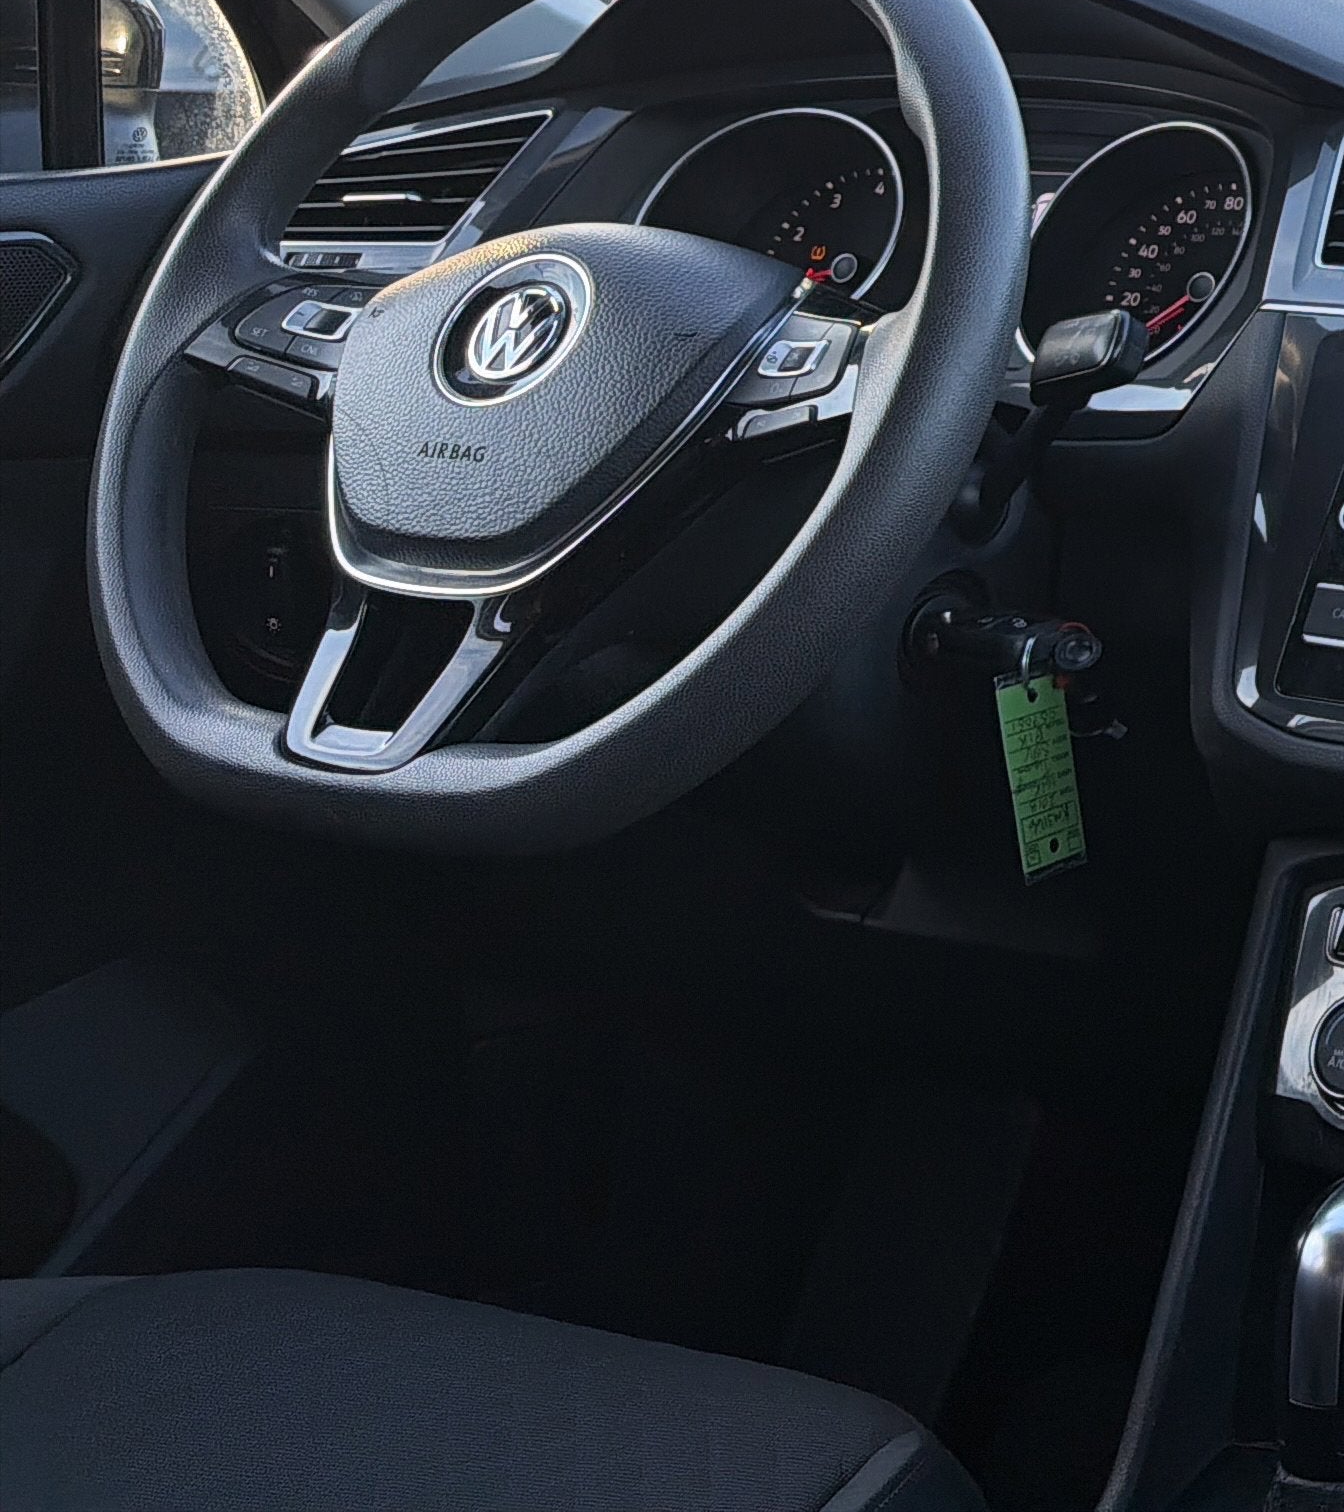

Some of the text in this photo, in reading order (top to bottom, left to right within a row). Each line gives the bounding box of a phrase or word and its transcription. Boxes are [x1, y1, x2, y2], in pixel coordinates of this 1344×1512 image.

[874, 181, 886, 196] 4
[830, 193, 842, 209] 3
[1203, 199, 1217, 210] 70
[1223, 196, 1245, 211] 80
[1176, 210, 1197, 225] 60
[793, 226, 805, 242] 2
[1157, 225, 1172, 236] 50
[1138, 244, 1159, 259] 40
[1128, 267, 1143, 279] 30
[1121, 291, 1141, 307] 20
[417, 441, 489, 464] AIRBAG
